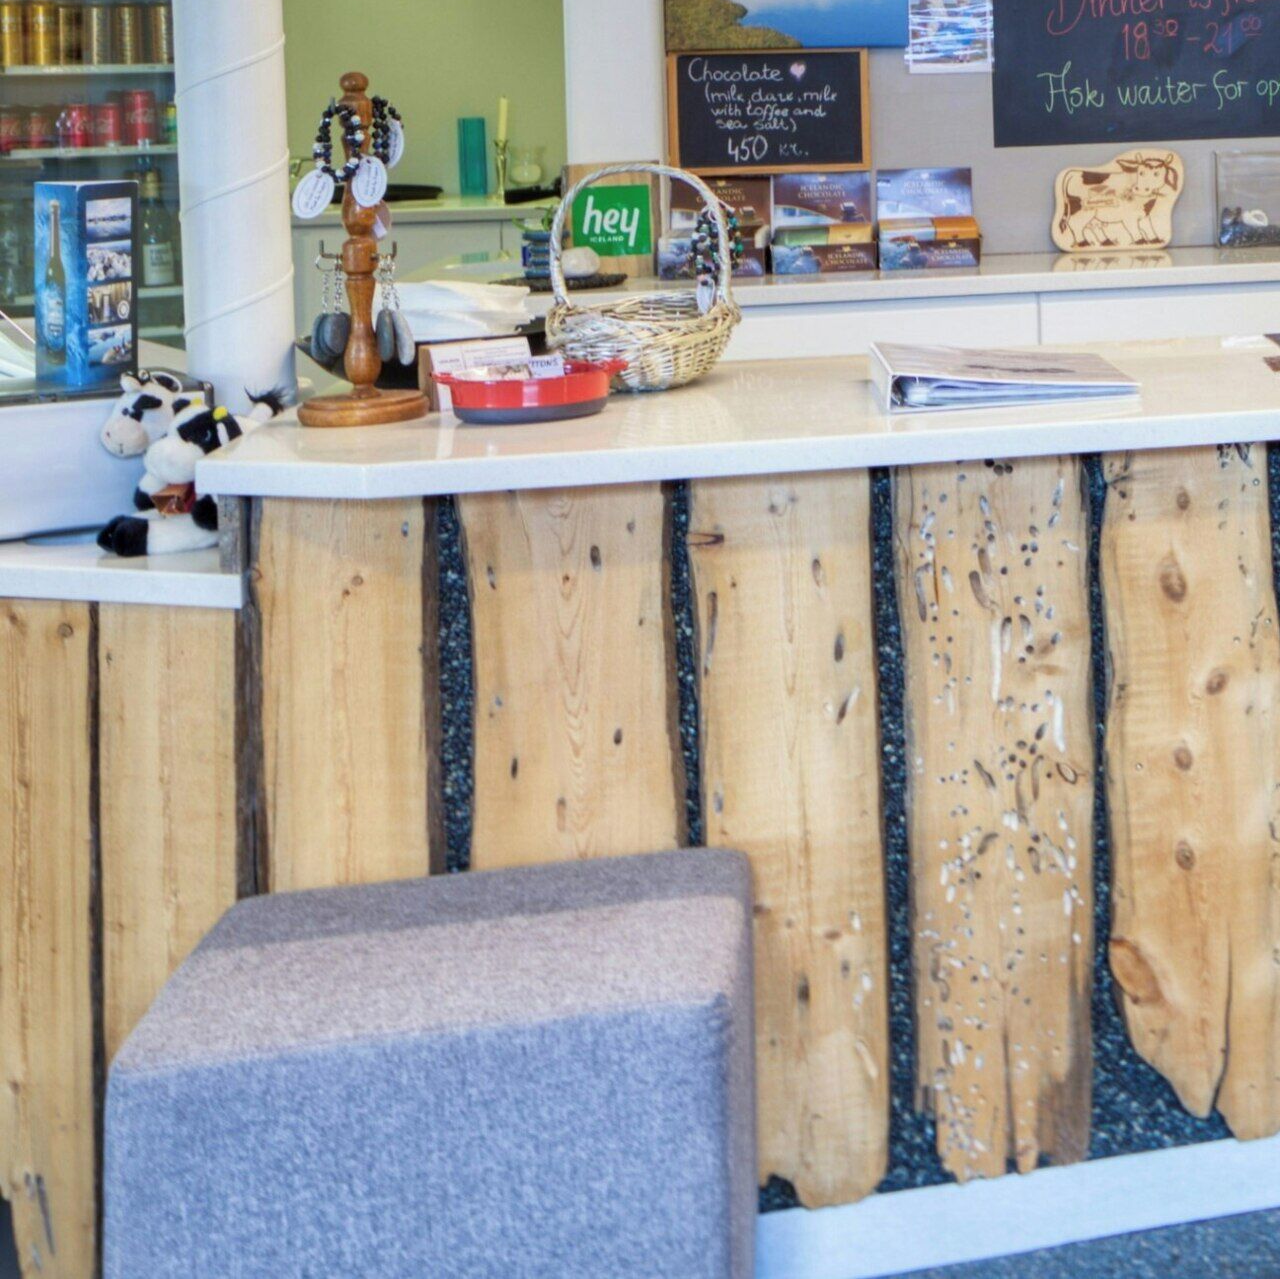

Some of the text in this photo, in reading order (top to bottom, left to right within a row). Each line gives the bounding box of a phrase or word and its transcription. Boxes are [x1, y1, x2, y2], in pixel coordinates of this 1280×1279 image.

[687, 57, 784, 83] Chocolate
[803, 84, 838, 103] milk
[1037, 60, 1105, 115] Ask
[1117, 77, 1207, 107] waiter
[1212, 70, 1249, 111] for
[710, 102, 828, 121] with toffee and
[715, 119, 749, 131] sea
[727, 134, 769, 163] 450
[582, 194, 641, 248] hey
